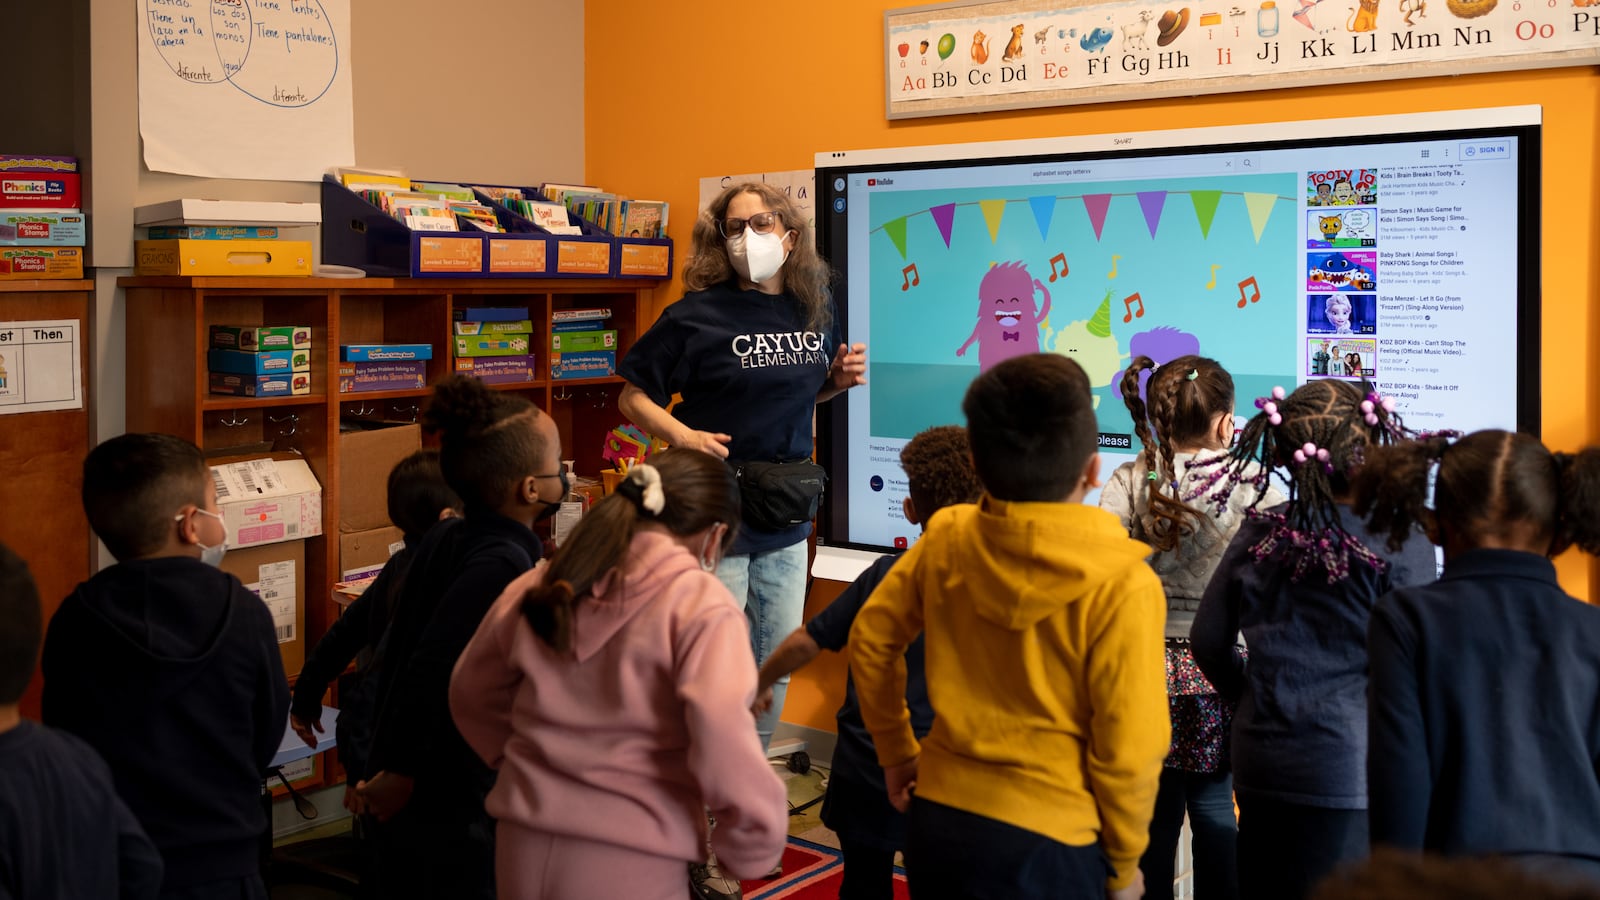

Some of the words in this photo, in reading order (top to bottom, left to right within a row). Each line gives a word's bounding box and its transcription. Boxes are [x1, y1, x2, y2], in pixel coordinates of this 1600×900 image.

[148, 10, 174, 23] Tiene
[213, 7, 226, 16] Los
[231, 8, 246, 20] dos
[224, 20, 240, 30] son
[215, 32, 244, 43] monos
[254, 22, 279, 38] Tiene
[285, 27, 333, 53] pantalones
[902, 75, 926, 92] Aa
[932, 72, 957, 89] Bb
[968, 69, 991, 86] Cc
[1001, 65, 1027, 84] Dd
[1043, 62, 1068, 80] Ee
[1088, 57, 1110, 75] Ff
[1121, 54, 1150, 75] Gg
[1158, 51, 1189, 71] Hh
[1217, 47, 1232, 65] Ii
[1256, 42, 1280, 64] Jj
[1300, 38, 1335, 59] Kk
[1351, 33, 1377, 55] Ll
[1392, 31, 1441, 51] Mm
[1454, 26, 1492, 47] Nn
[1515, 20, 1554, 41] Oo
[177, 61, 212, 81] diferente
[223, 58, 241, 75] igual
[273, 85, 307, 102] diferente
[1437, 170, 1452, 178] Tooty
[4, 182, 45, 191] Phonics
[33, 329, 63, 340] Then
